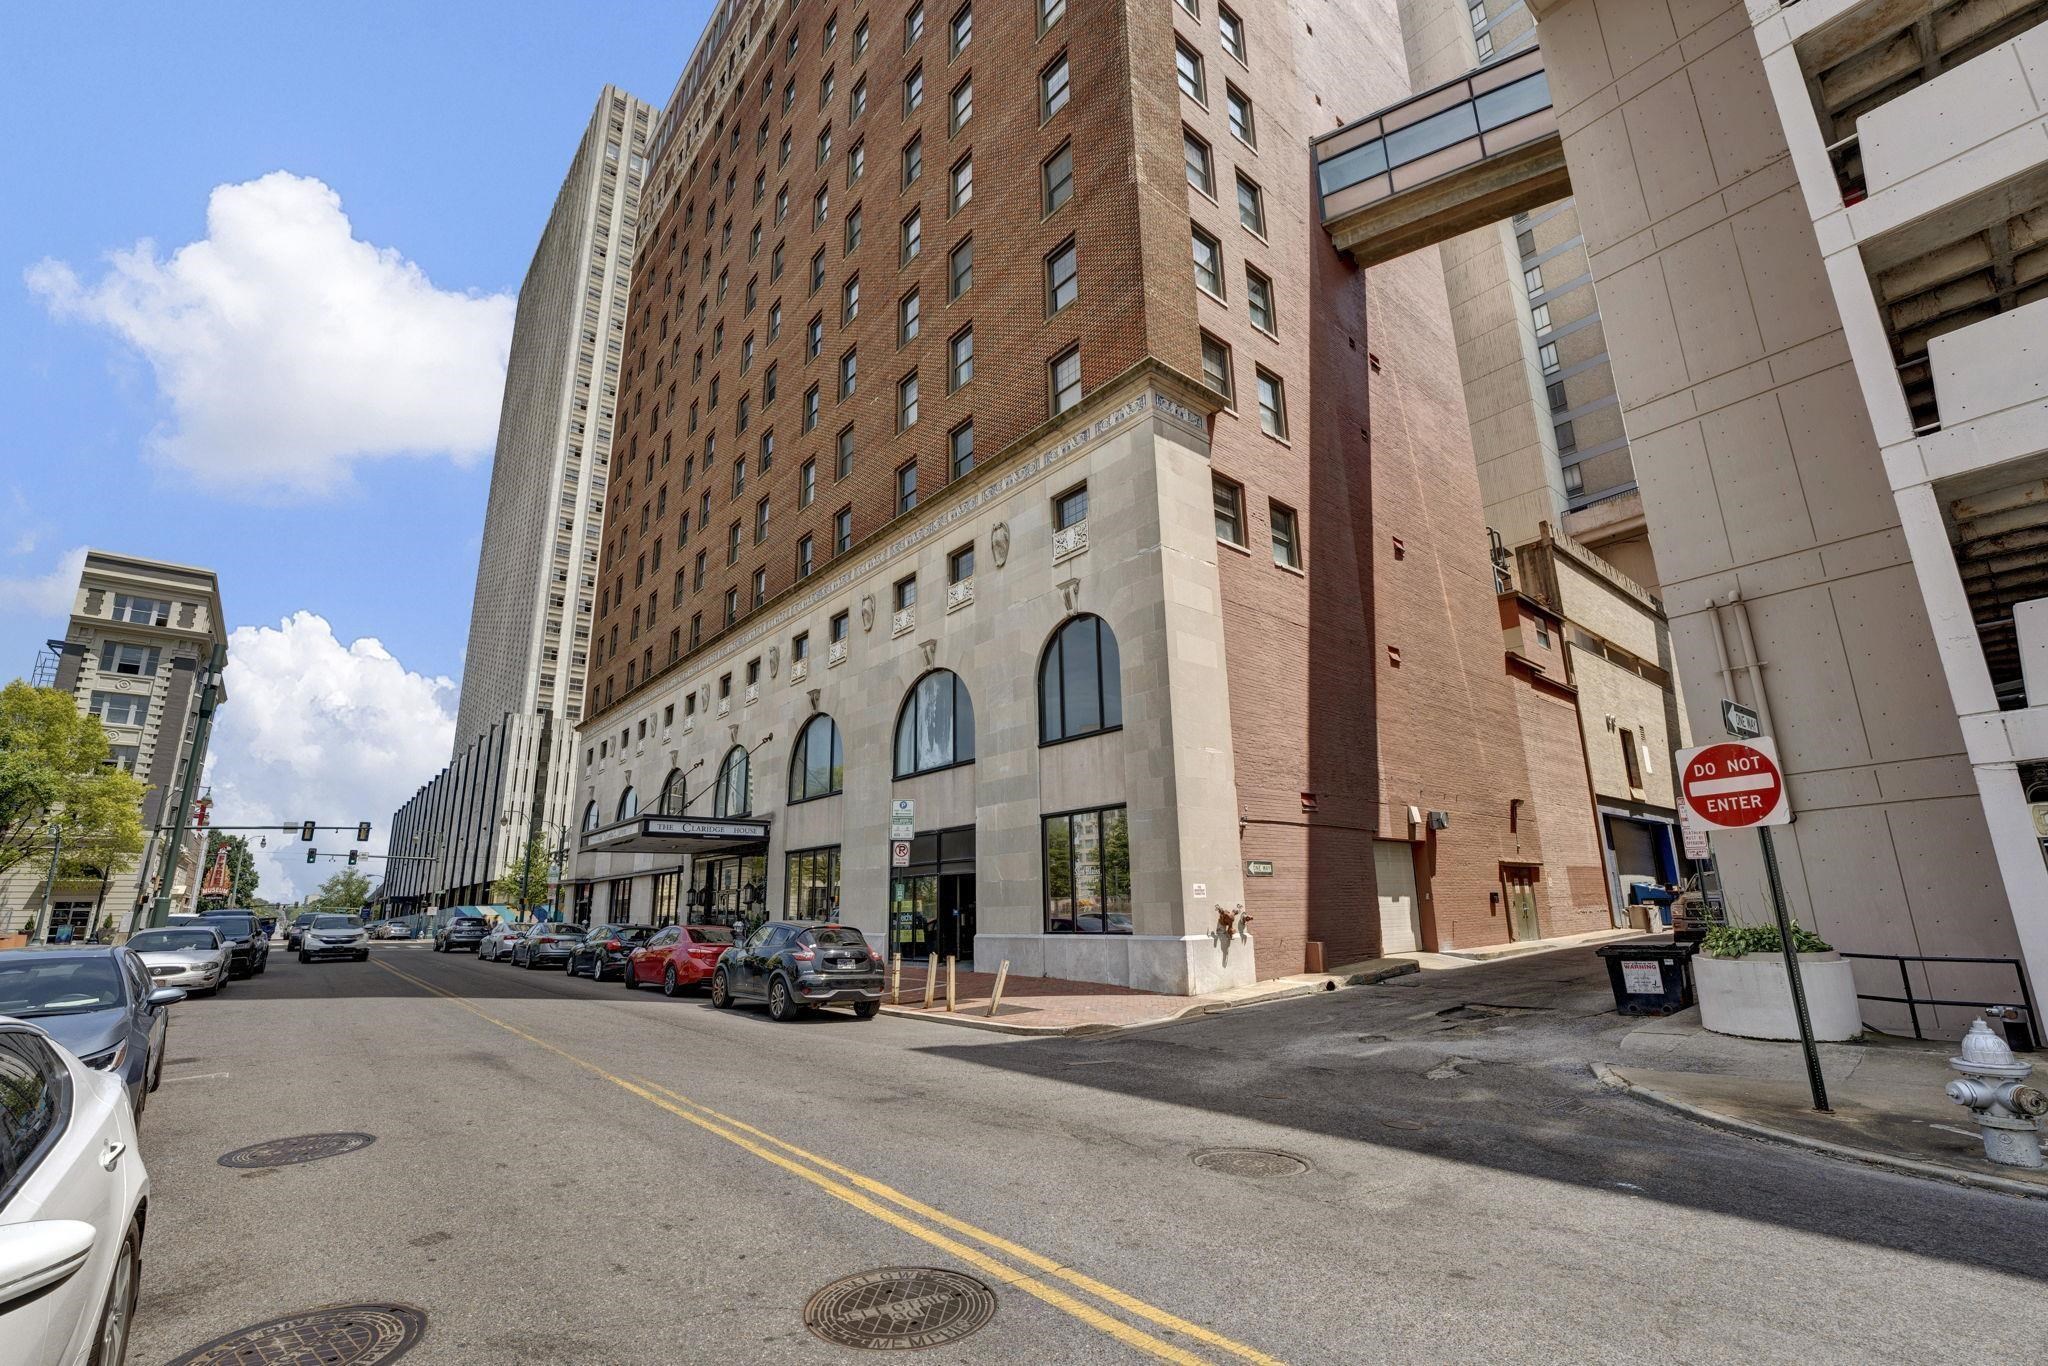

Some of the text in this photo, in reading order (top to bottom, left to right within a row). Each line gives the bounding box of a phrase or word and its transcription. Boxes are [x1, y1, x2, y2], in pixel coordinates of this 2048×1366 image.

[1736, 713, 1756, 731] ONE WAY
[1694, 756, 1760, 777] DO NOT
[1707, 795, 1762, 813] ENTER
[657, 823, 674, 831] THE
[682, 823, 725, 833] CLARIDGE
[214, 856, 225, 885] FIRE
[872, 1320, 974, 1350] MEMPHIS
